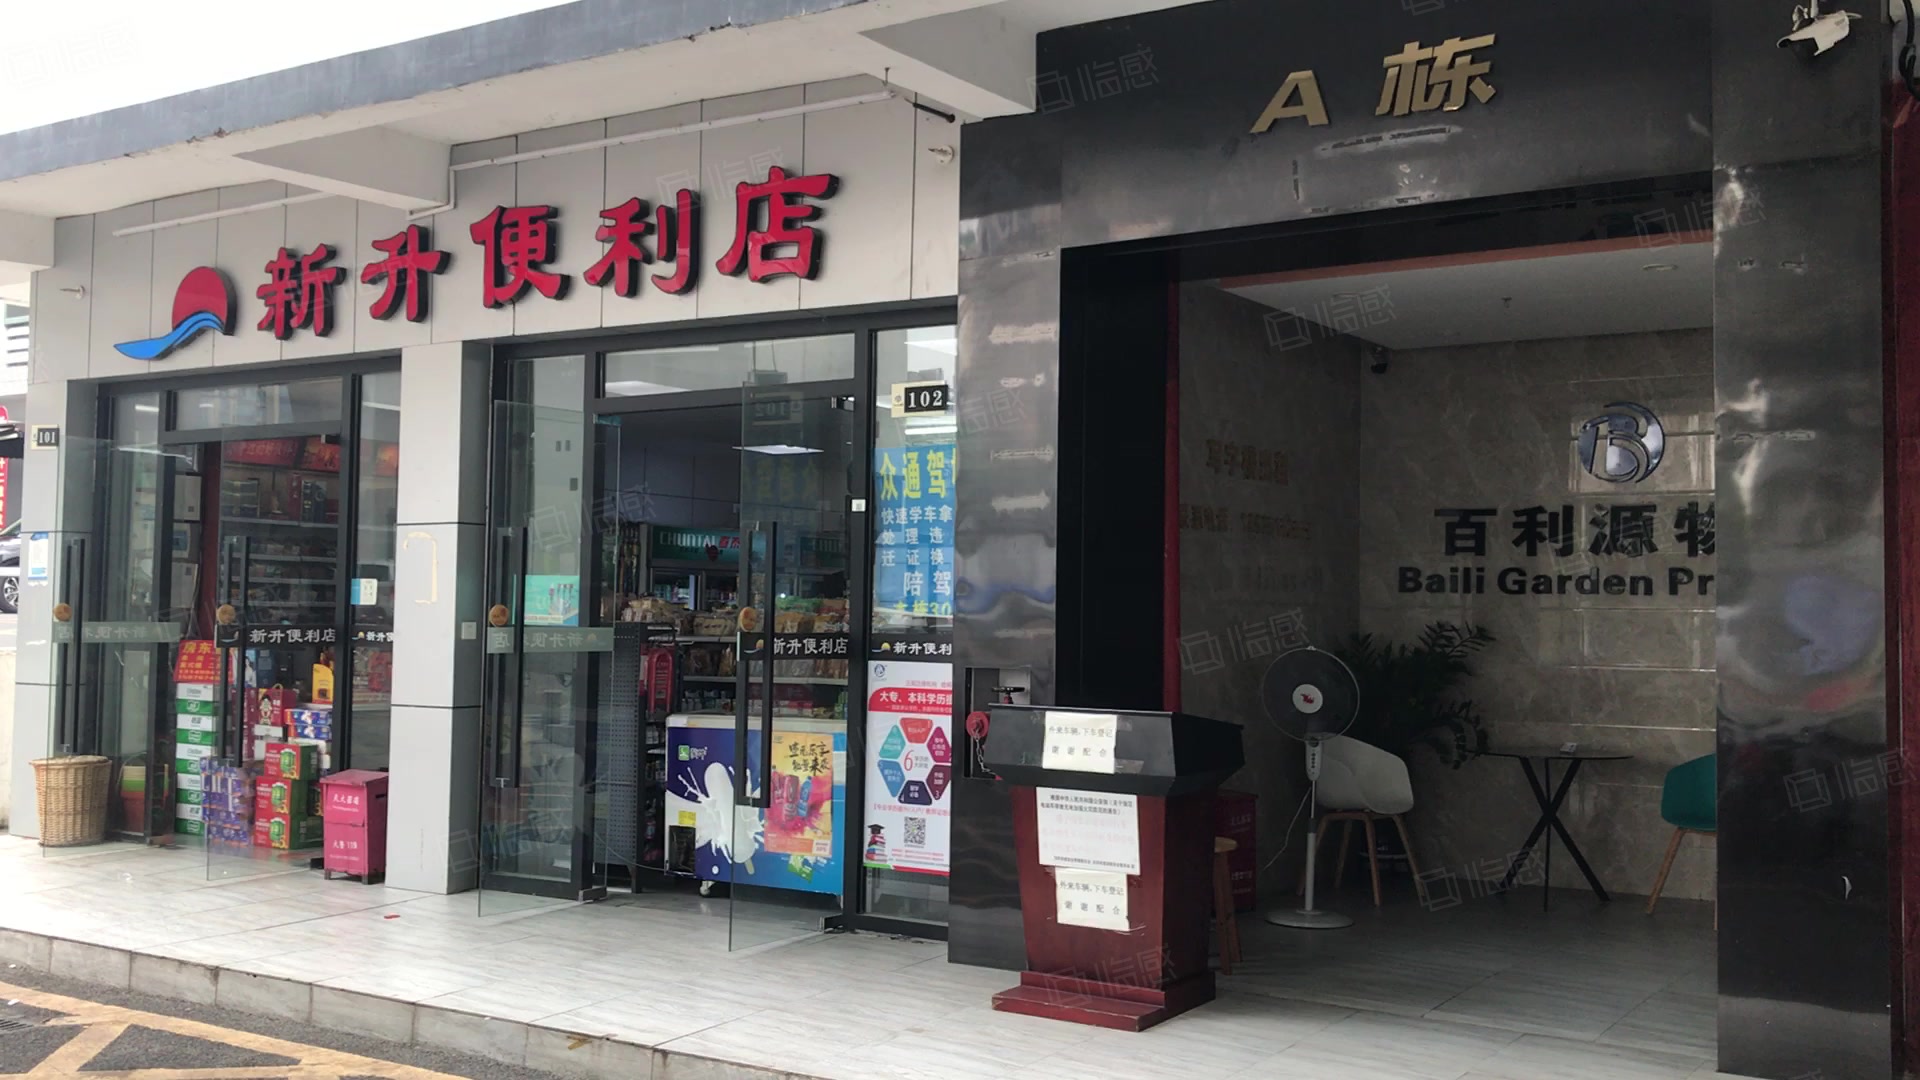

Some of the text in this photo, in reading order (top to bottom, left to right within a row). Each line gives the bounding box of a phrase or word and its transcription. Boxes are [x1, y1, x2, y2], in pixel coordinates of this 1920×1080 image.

[257, 166, 840, 342] 新升便利店
[907, 390, 944, 409] 102
[38, 431, 56, 444] 101
[880, 448, 956, 500] 众通驾
[881, 504, 953, 525] 快速学车拿
[882, 526, 943, 546] 处理违
[1434, 501, 1715, 557] 百利源物
[903, 570, 951, 598] 陪驾
[1399, 566, 1715, 596] Baili Garden Pr
[250, 628, 336, 644] 新升便利店
[893, 641, 952, 656] 新升便利
[903, 749, 915, 772] 6
